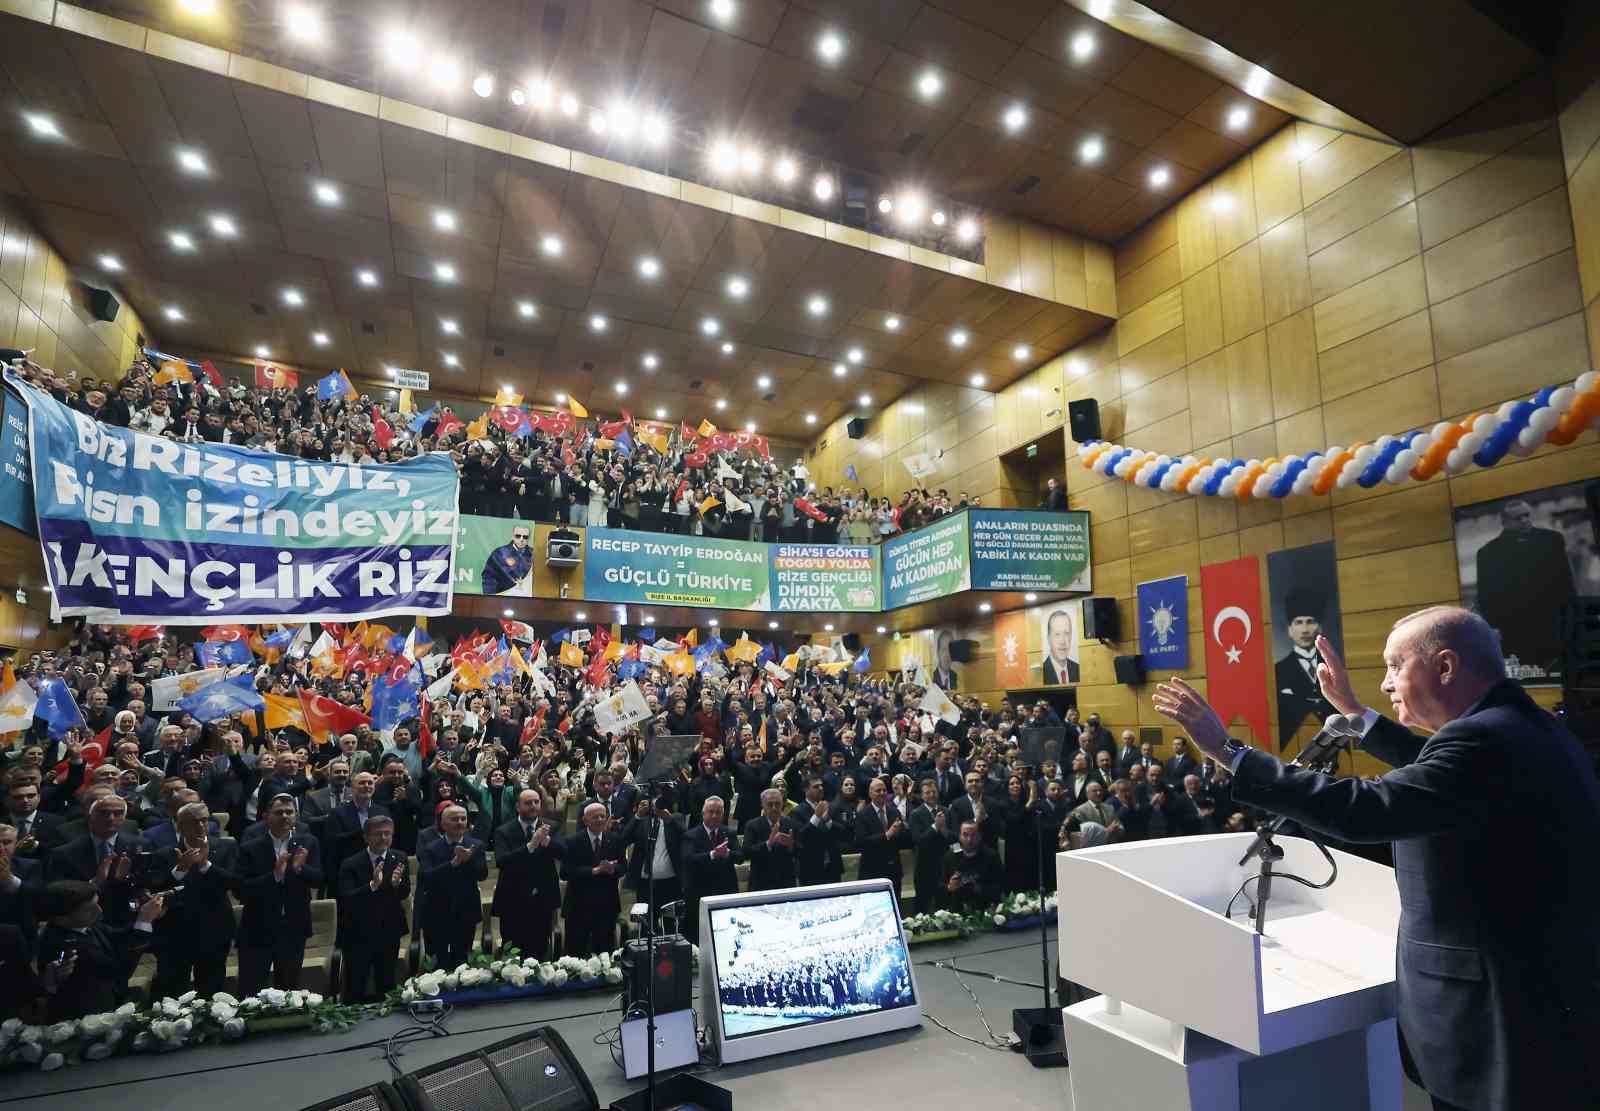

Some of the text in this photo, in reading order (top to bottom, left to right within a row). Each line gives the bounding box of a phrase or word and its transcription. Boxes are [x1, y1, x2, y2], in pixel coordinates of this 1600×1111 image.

[975, 521, 1082, 532] ANALARIN DUASINDA
[974, 532, 990, 540] HER
[992, 531, 1011, 541] GÜN
[592, 538, 763, 563] RECEP TAYYİP ERDOĞAN
[827, 546, 869, 558] GÖKTE
[932, 540, 954, 560] HEP
[1012, 551, 1026, 560] AK
[1029, 552, 1061, 560] KADIN
[1064, 553, 1085, 561] VAR
[779, 559, 871, 569] TOGG'U YOLDA
[604, 566, 752, 591] GÜÇLÜ TÜRKİYE
[778, 570, 872, 584] RİZE GENÇLİĞİ
[890, 573, 904, 590] AK
[905, 554, 962, 585] KADINDAN
[107, 551, 341, 611] ENÇLİK
[778, 582, 836, 597] DİMDİK
[778, 597, 842, 610] AYAKTA
